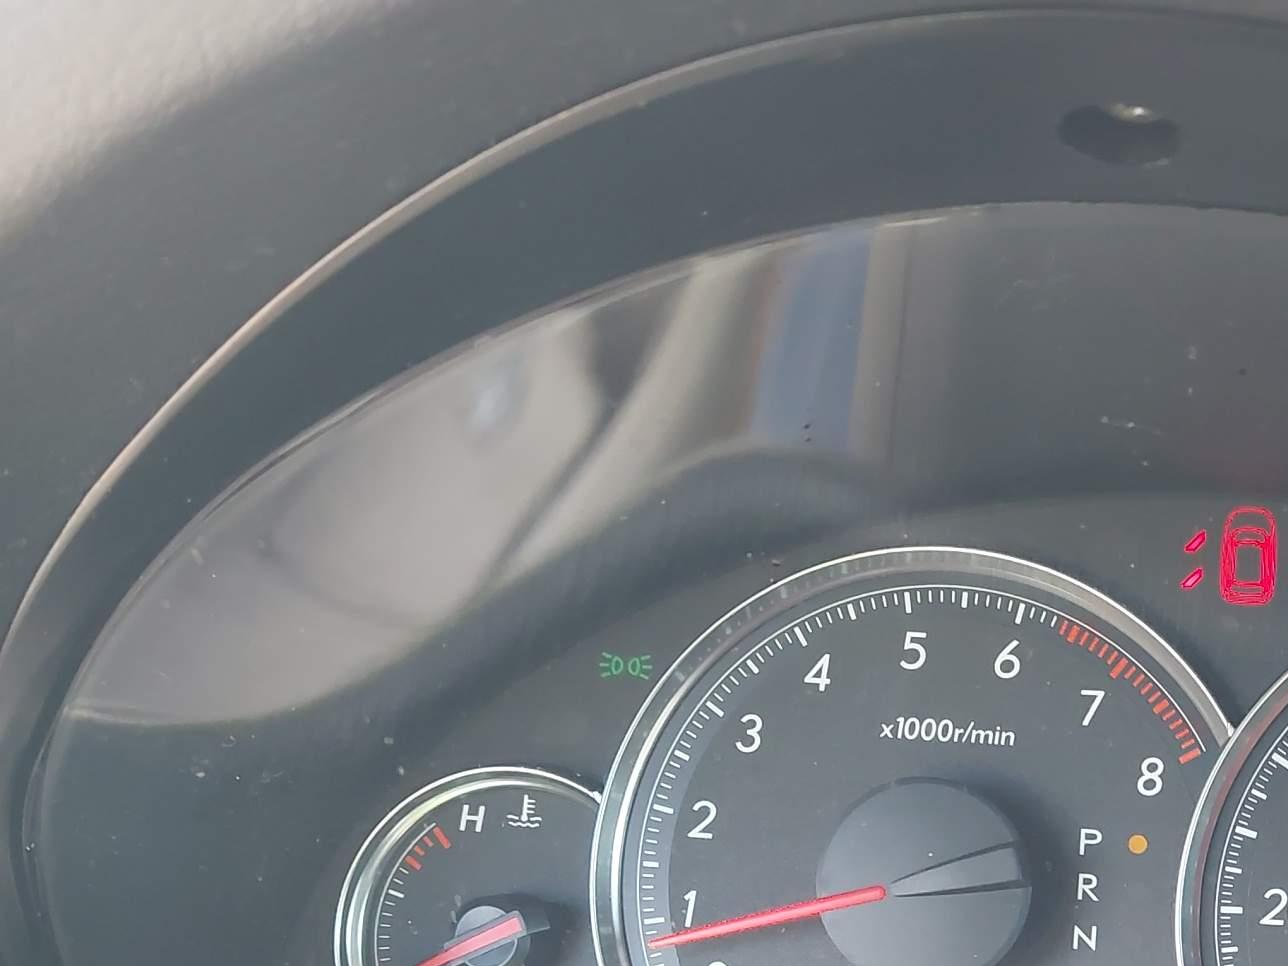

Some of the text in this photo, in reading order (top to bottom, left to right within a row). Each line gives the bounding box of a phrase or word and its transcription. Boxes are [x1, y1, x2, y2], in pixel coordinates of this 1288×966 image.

[900, 632, 926, 669] 5
[995, 640, 1020, 678] 6
[804, 654, 830, 691] 4
[1081, 690, 1104, 725] 7
[736, 714, 762, 752] 3
[880, 717, 1014, 745] x1000r/min
[1138, 758, 1163, 796] 8
[460, 805, 485, 832] H
[688, 801, 716, 838] 2
[1080, 829, 1102, 855] P
[1078, 874, 1098, 901] R
[683, 891, 698, 928] 1
[1073, 926, 1096, 951] N
